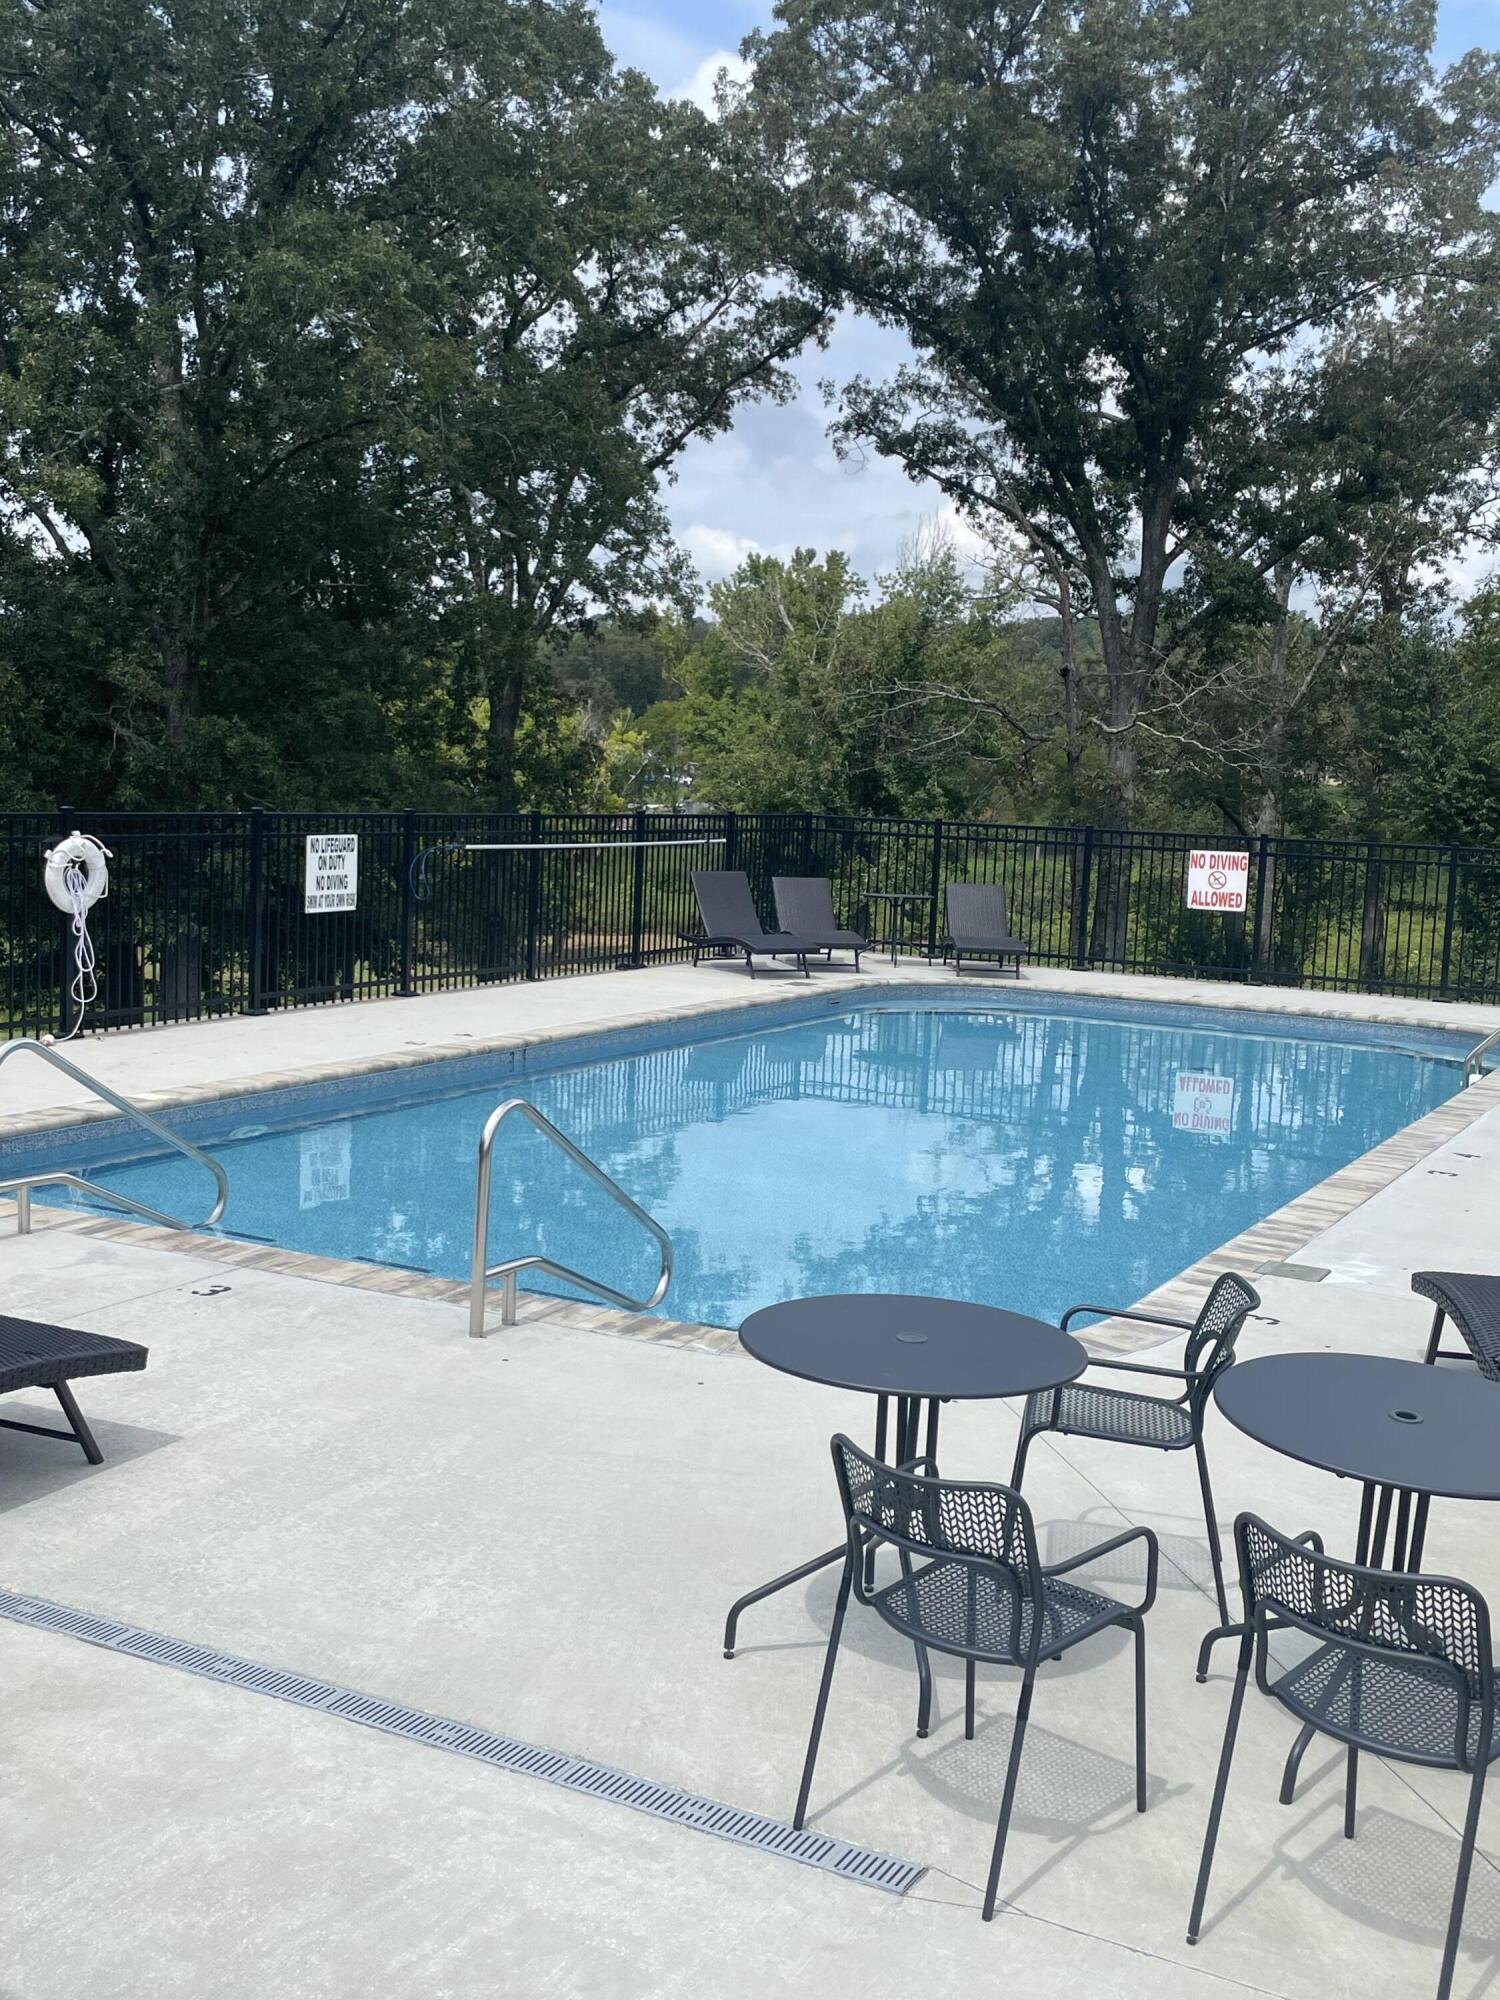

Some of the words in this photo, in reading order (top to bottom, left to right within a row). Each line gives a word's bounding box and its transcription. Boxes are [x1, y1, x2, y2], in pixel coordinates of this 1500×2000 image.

[310, 838, 320, 854] NO
[321, 837, 355, 853] LIFEGUARD
[318, 855, 327, 871] ON
[329, 854, 345, 870] DUTY
[1191, 854, 1206, 868] NO
[1209, 855, 1247, 871] DIVING
[316, 875, 325, 891] NO
[326, 874, 348, 890] DIVING
[1191, 890, 1242, 908] ALLOWED
